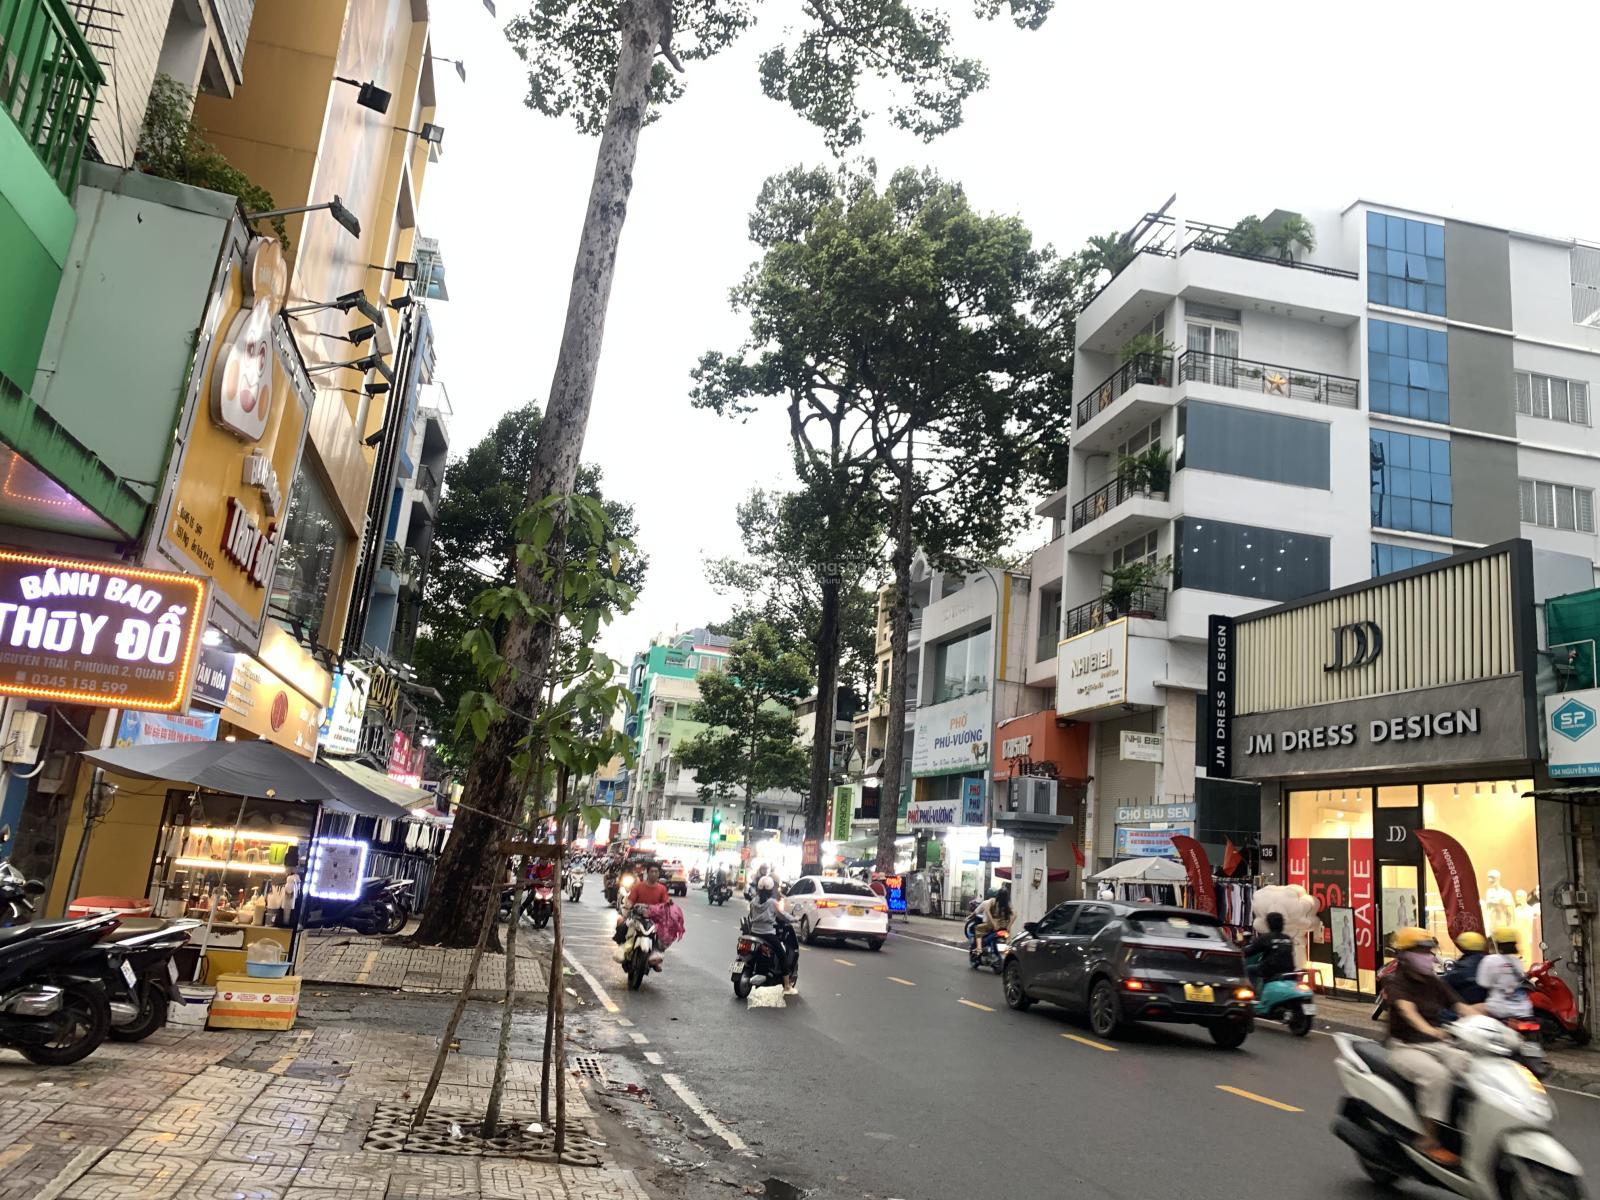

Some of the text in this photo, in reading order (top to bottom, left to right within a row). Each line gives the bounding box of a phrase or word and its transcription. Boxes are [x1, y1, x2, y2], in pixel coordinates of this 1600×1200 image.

[20, 567, 162, 614] BÁNH BAO
[115, 604, 187, 665] ĐỖ
[31, 674, 128, 694] 0345 158 599
[167, 671, 175, 682] 5
[211, 670, 228, 692] HÓA
[1216, 624, 1227, 768] JM DRESS DESIGN
[1560, 711, 1586, 724] SP
[1245, 708, 1480, 755] JM DRESS DESIGN
[1167, 806, 1191, 819] SEN
[1262, 848, 1273, 857] 136
[1441, 848, 1457, 875] DESIGN
[1353, 859, 1372, 948] SALE
